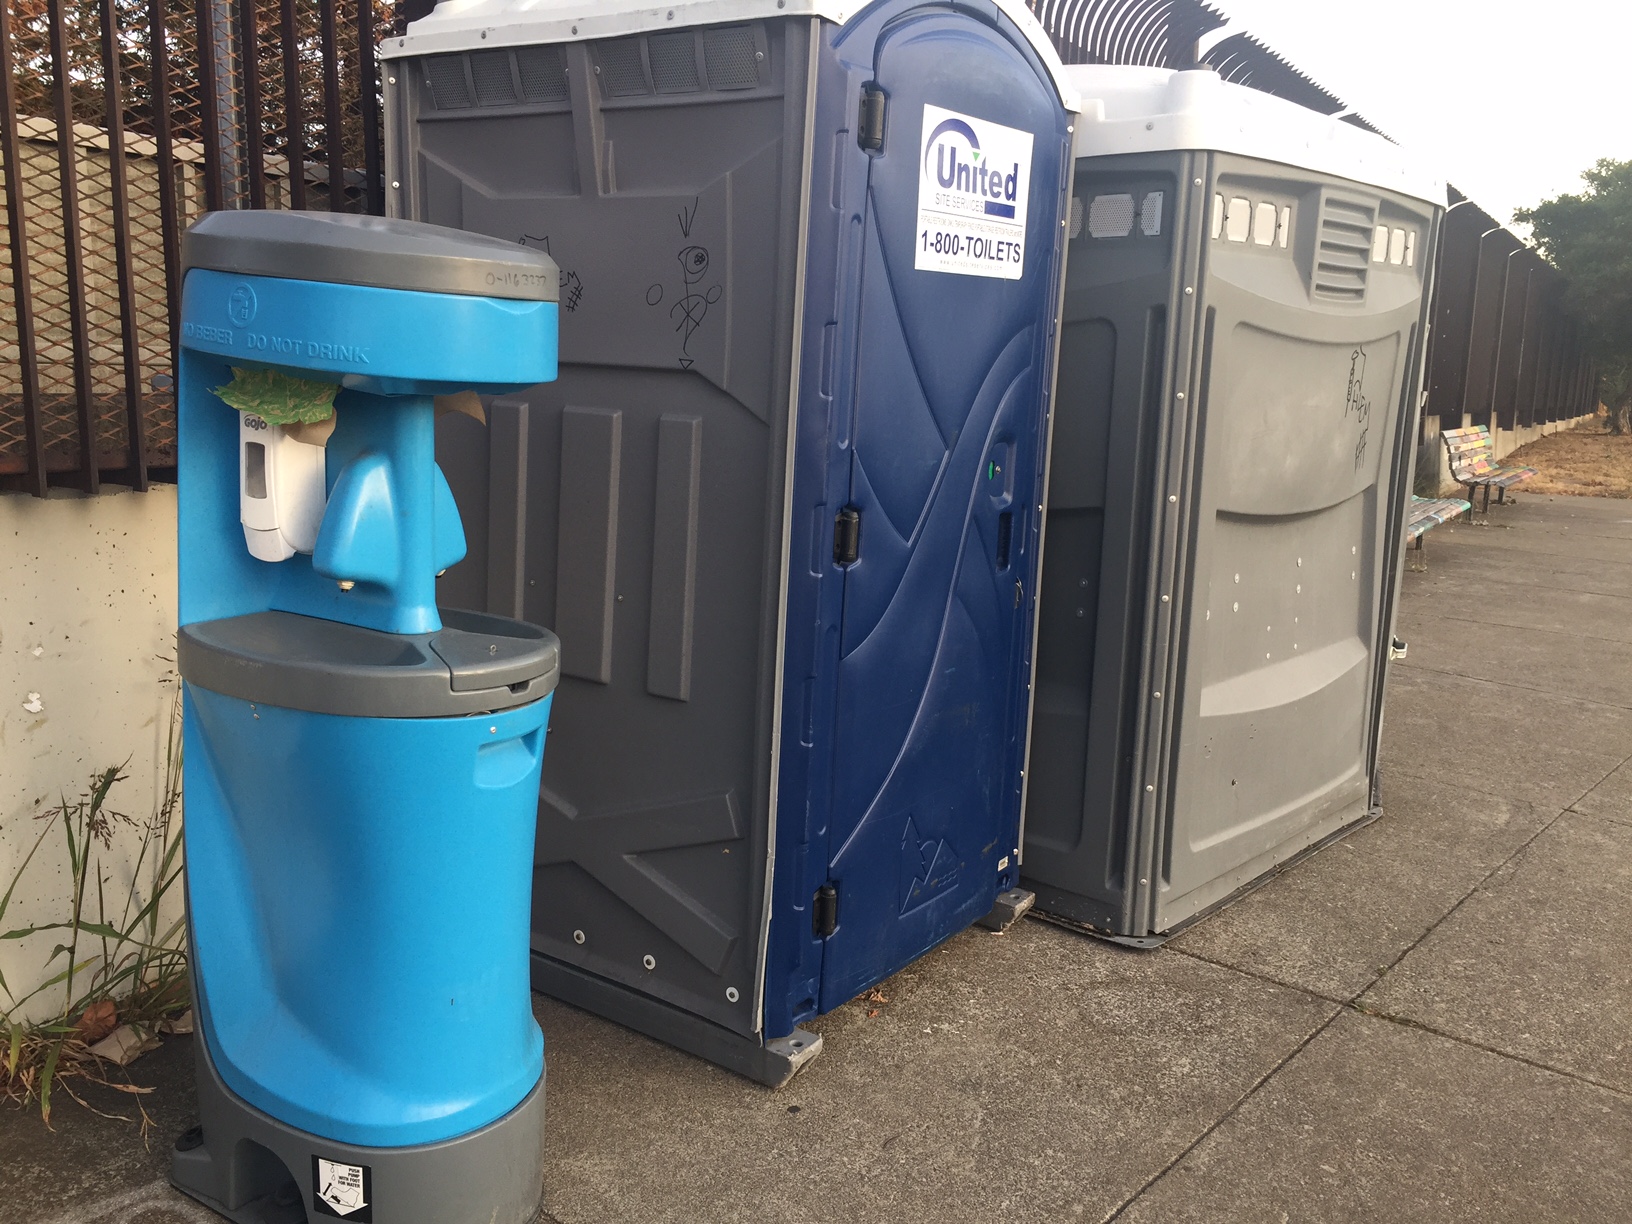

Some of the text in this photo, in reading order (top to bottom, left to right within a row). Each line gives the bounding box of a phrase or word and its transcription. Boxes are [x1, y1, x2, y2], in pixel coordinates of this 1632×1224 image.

[936, 143, 1019, 202] United
[935, 192, 984, 213] SITE SERVICES
[921, 229, 1021, 263] 1-800-TOILETS
[196, 324, 233, 345] BEBER
[247, 332, 370, 364] DO NOT DRINK
